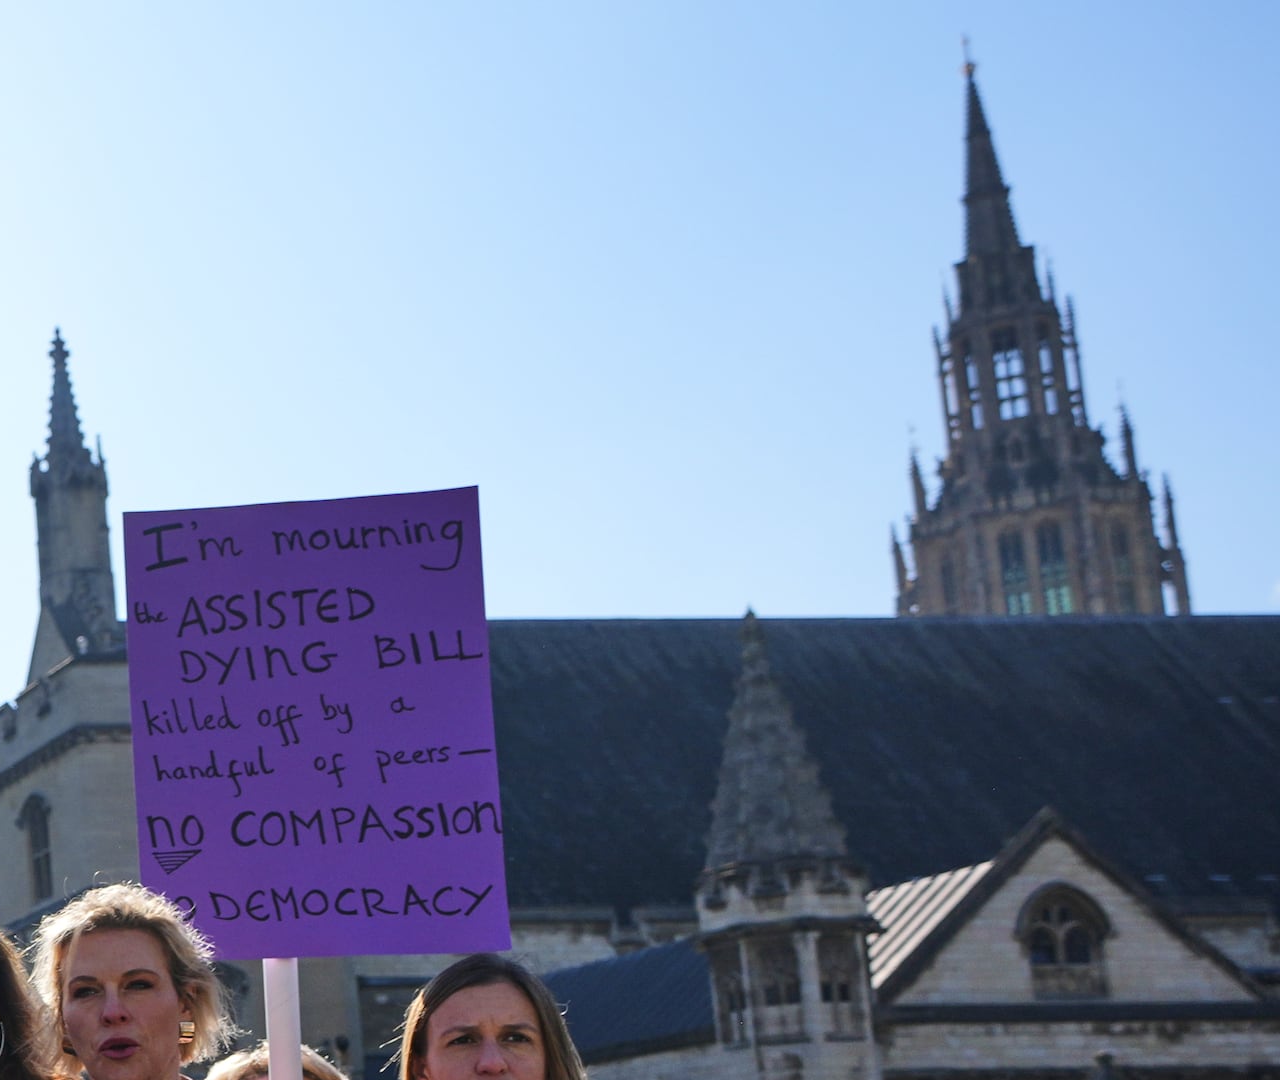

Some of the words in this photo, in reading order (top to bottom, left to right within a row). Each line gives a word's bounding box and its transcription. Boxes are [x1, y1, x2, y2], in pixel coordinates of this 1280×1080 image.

[142, 520, 243, 572] I'm
[272, 518, 465, 572] mourning
[134, 600, 169, 626] the
[176, 586, 376, 639] ASSISTED
[373, 629, 484, 669] BILL
[141, 696, 242, 737] killed
[257, 704, 304, 747] off
[319, 693, 354, 734] by
[390, 696, 416, 714] a
[153, 744, 276, 798] handful
[313, 754, 347, 788] of
[208, 883, 494, 922] DEMOCRACY
